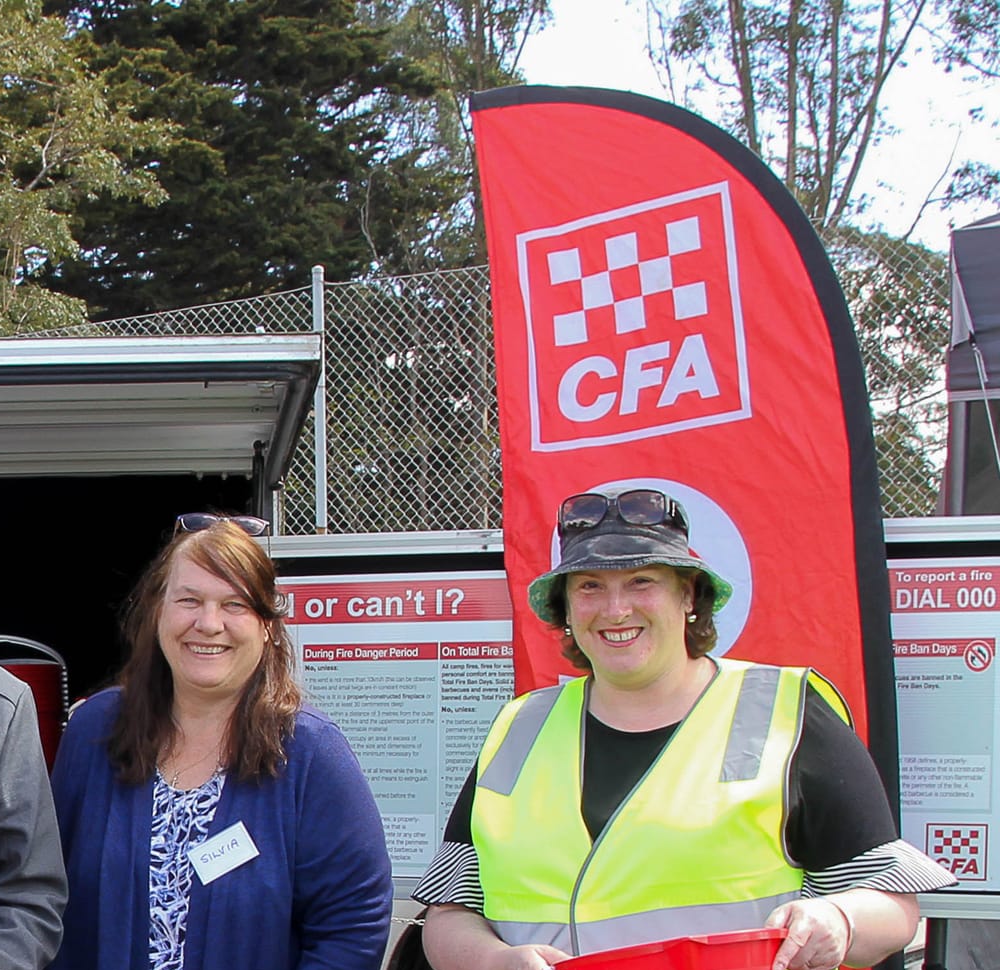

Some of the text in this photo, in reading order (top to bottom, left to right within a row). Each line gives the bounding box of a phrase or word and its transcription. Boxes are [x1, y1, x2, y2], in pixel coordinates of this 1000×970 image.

[557, 333, 720, 423] CFA
[895, 569, 992, 584] To report a fire
[305, 597, 338, 618] or
[435, 588, 465, 615] I?
[895, 587, 996, 609] DIAL 000
[304, 647, 419, 660] During Fire Danger Period
[441, 645, 514, 656] On Total Fire Ba
[909, 643, 930, 654] Ban
[932, 643, 957, 656] Days
[200, 838, 239, 864] SILVIA
